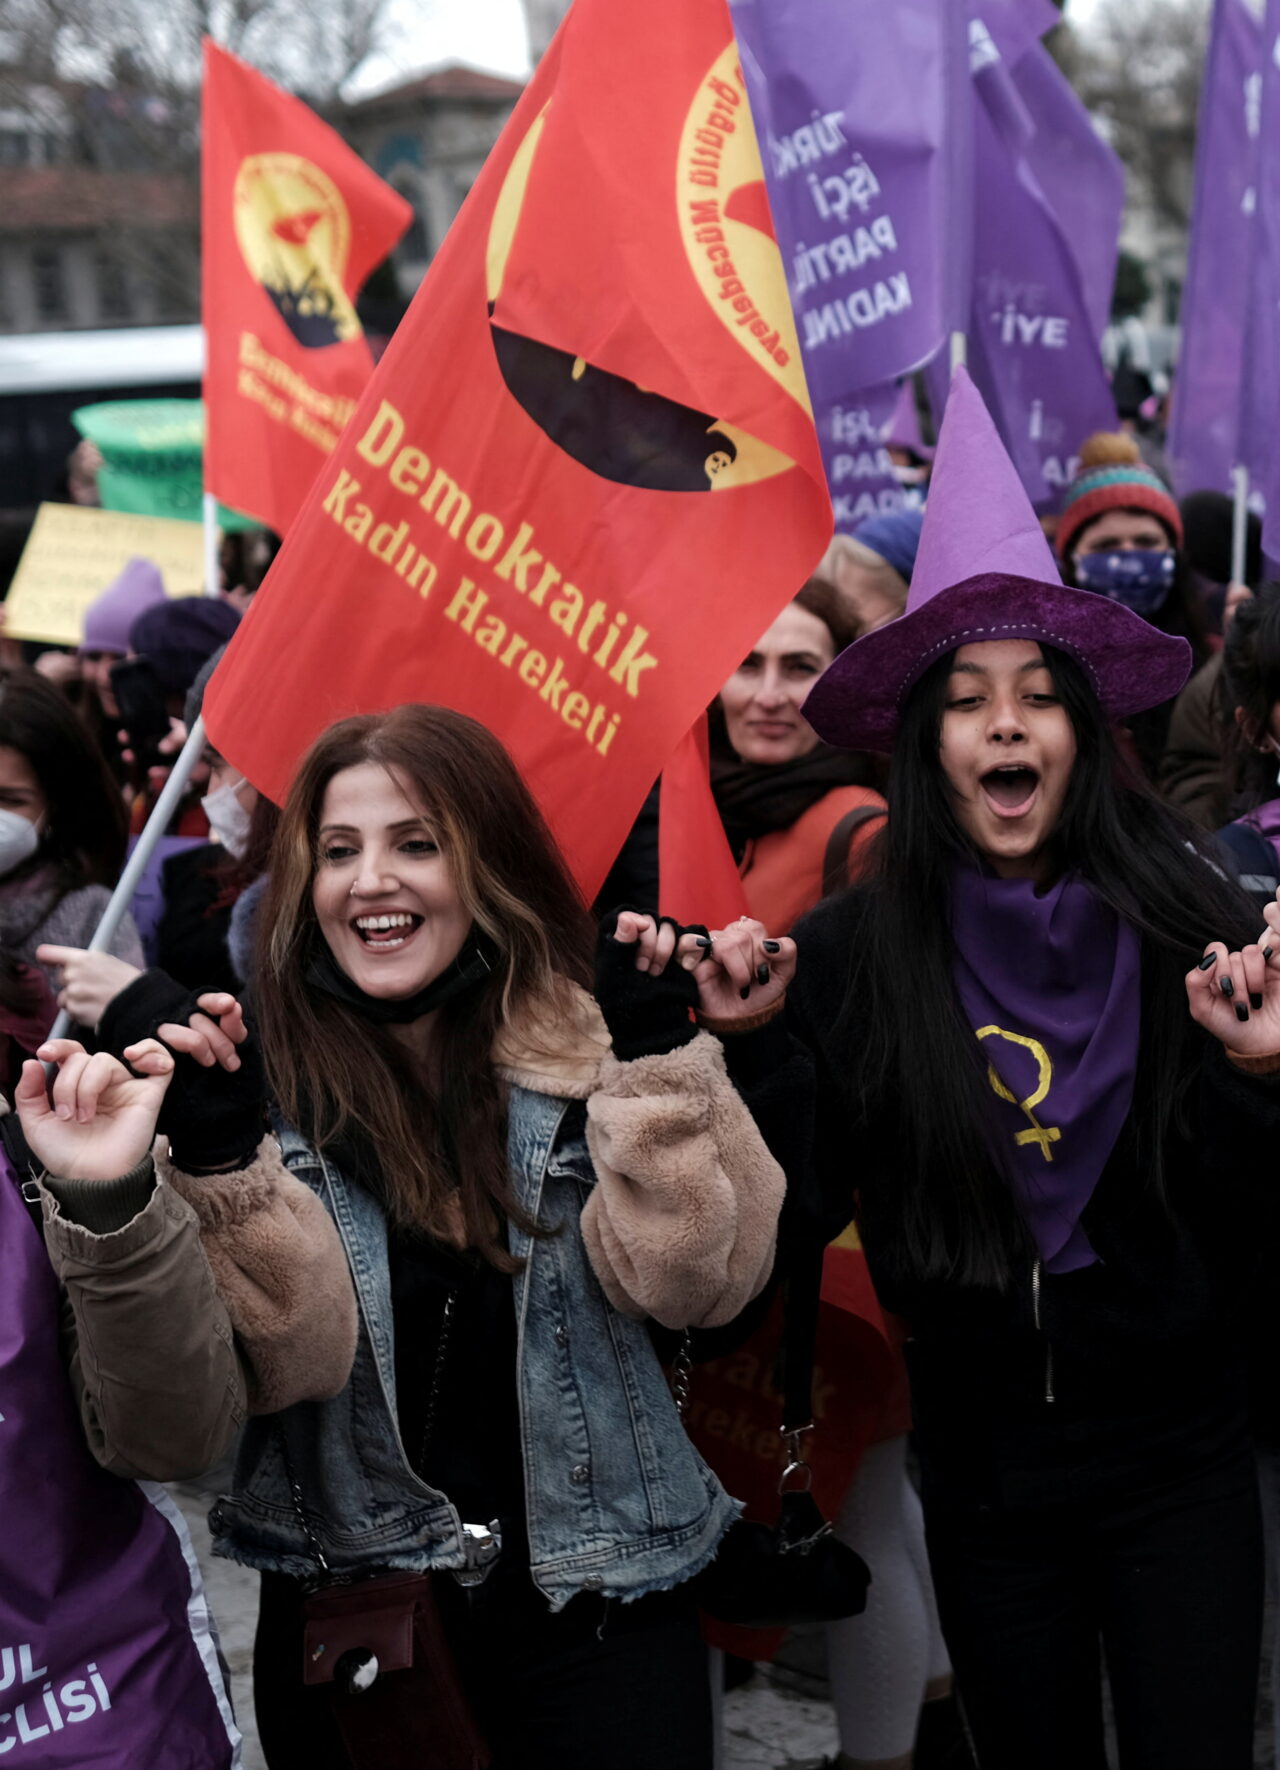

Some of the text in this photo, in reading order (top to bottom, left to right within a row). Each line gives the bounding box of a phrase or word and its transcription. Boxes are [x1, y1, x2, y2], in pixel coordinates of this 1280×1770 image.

[322, 468, 438, 599] Kadın
[444, 576, 621, 756] Hareketi
[356, 398, 658, 698] Demokratik
